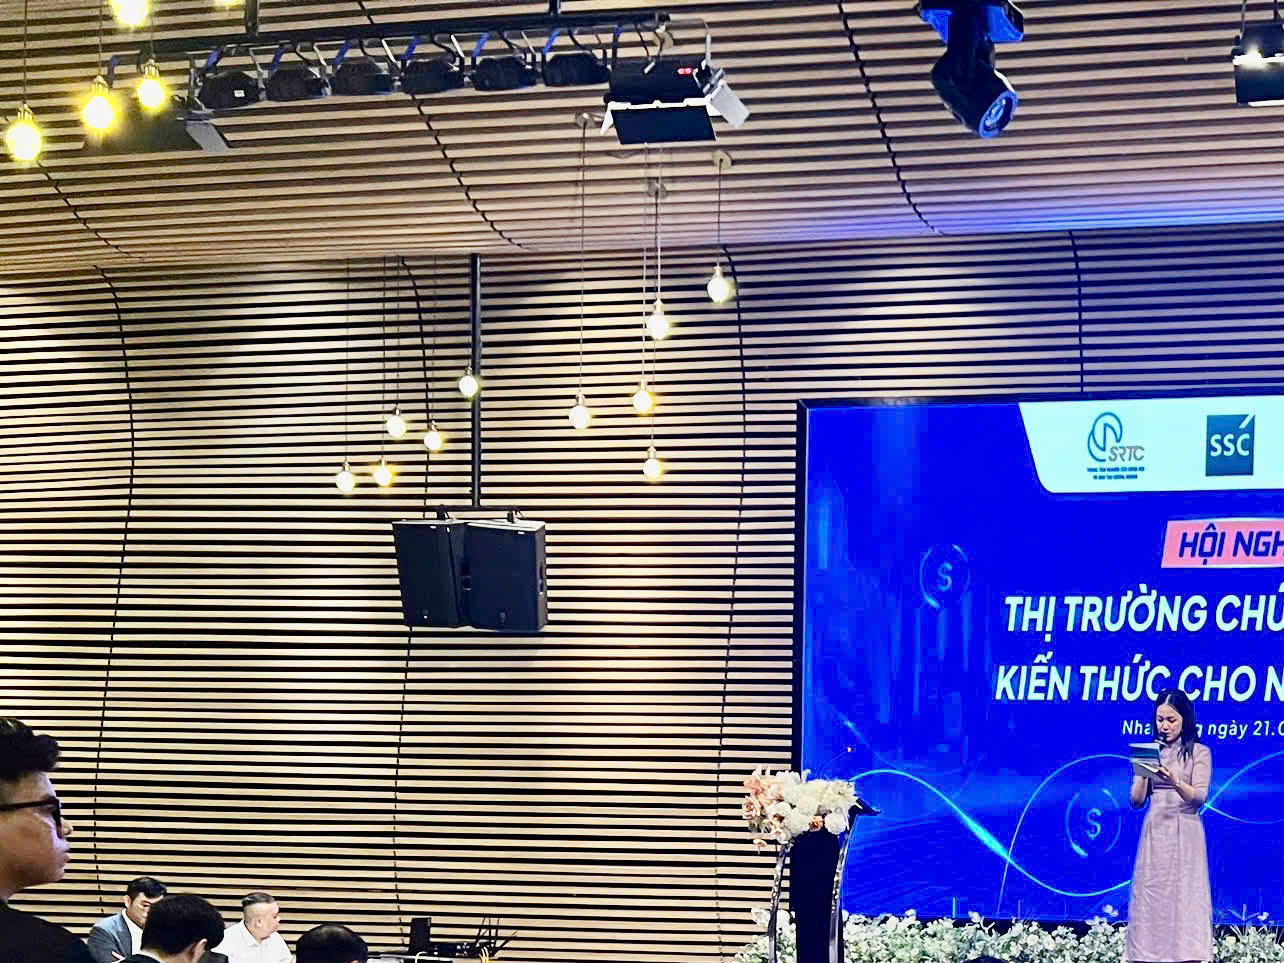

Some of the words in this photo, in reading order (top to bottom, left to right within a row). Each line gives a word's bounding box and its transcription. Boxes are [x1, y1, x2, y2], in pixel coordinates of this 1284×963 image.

[1108, 445, 1145, 462] SRTC
[1209, 433, 1250, 457] SSC
[1178, 522, 1226, 566] HỘI
[1004, 595, 1056, 643] THỊ
[1063, 583, 1208, 633] TRƯỜNG
[995, 651, 1072, 701] KIẾN
[1079, 653, 1171, 702] THỨC
[1178, 665, 1257, 702] CHO
[1207, 719, 1249, 740] ngày
